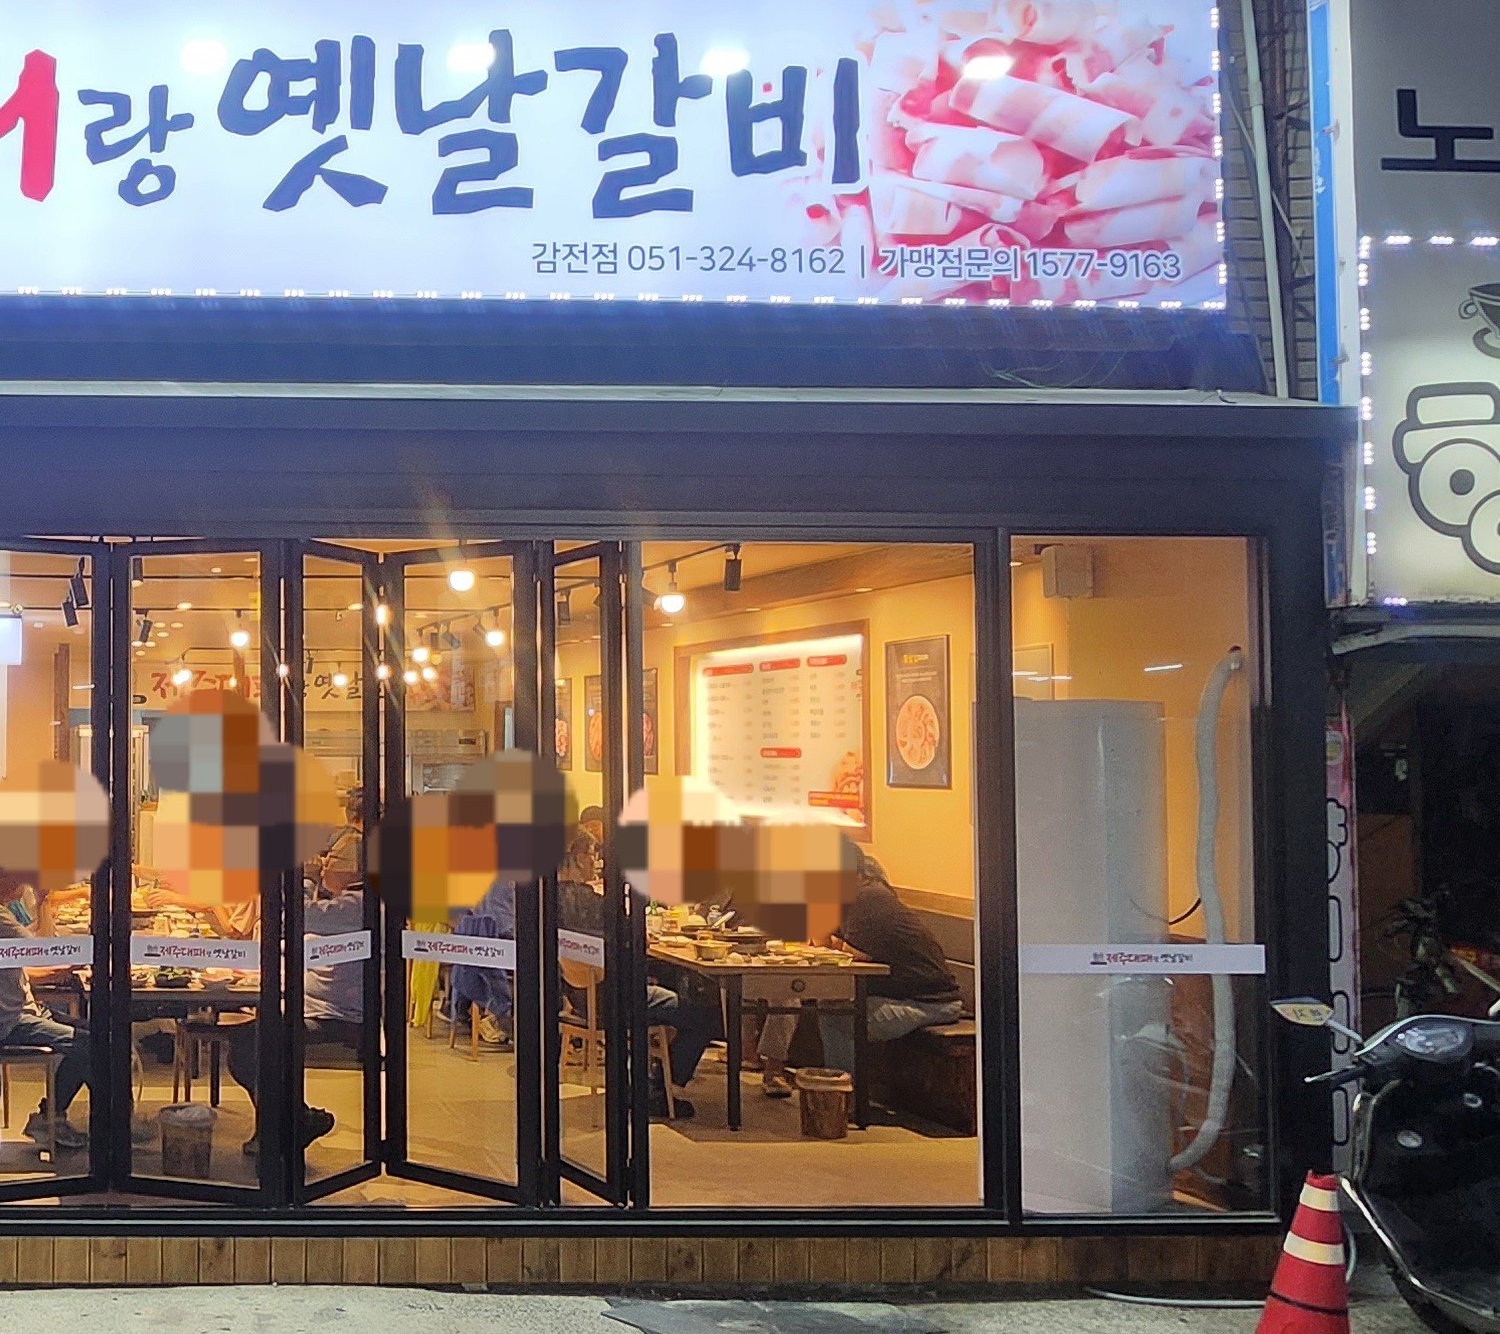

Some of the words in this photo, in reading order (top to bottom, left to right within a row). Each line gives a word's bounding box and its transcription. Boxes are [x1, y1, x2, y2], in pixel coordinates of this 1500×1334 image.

[218, 28, 862, 221] 옛날갈비
[531, 241, 620, 276] 감전점
[627, 242, 847, 275] 051-324-8162
[878, 244, 1020, 279] 가맹점문의
[1026, 248, 1182, 280] 1577-9163
